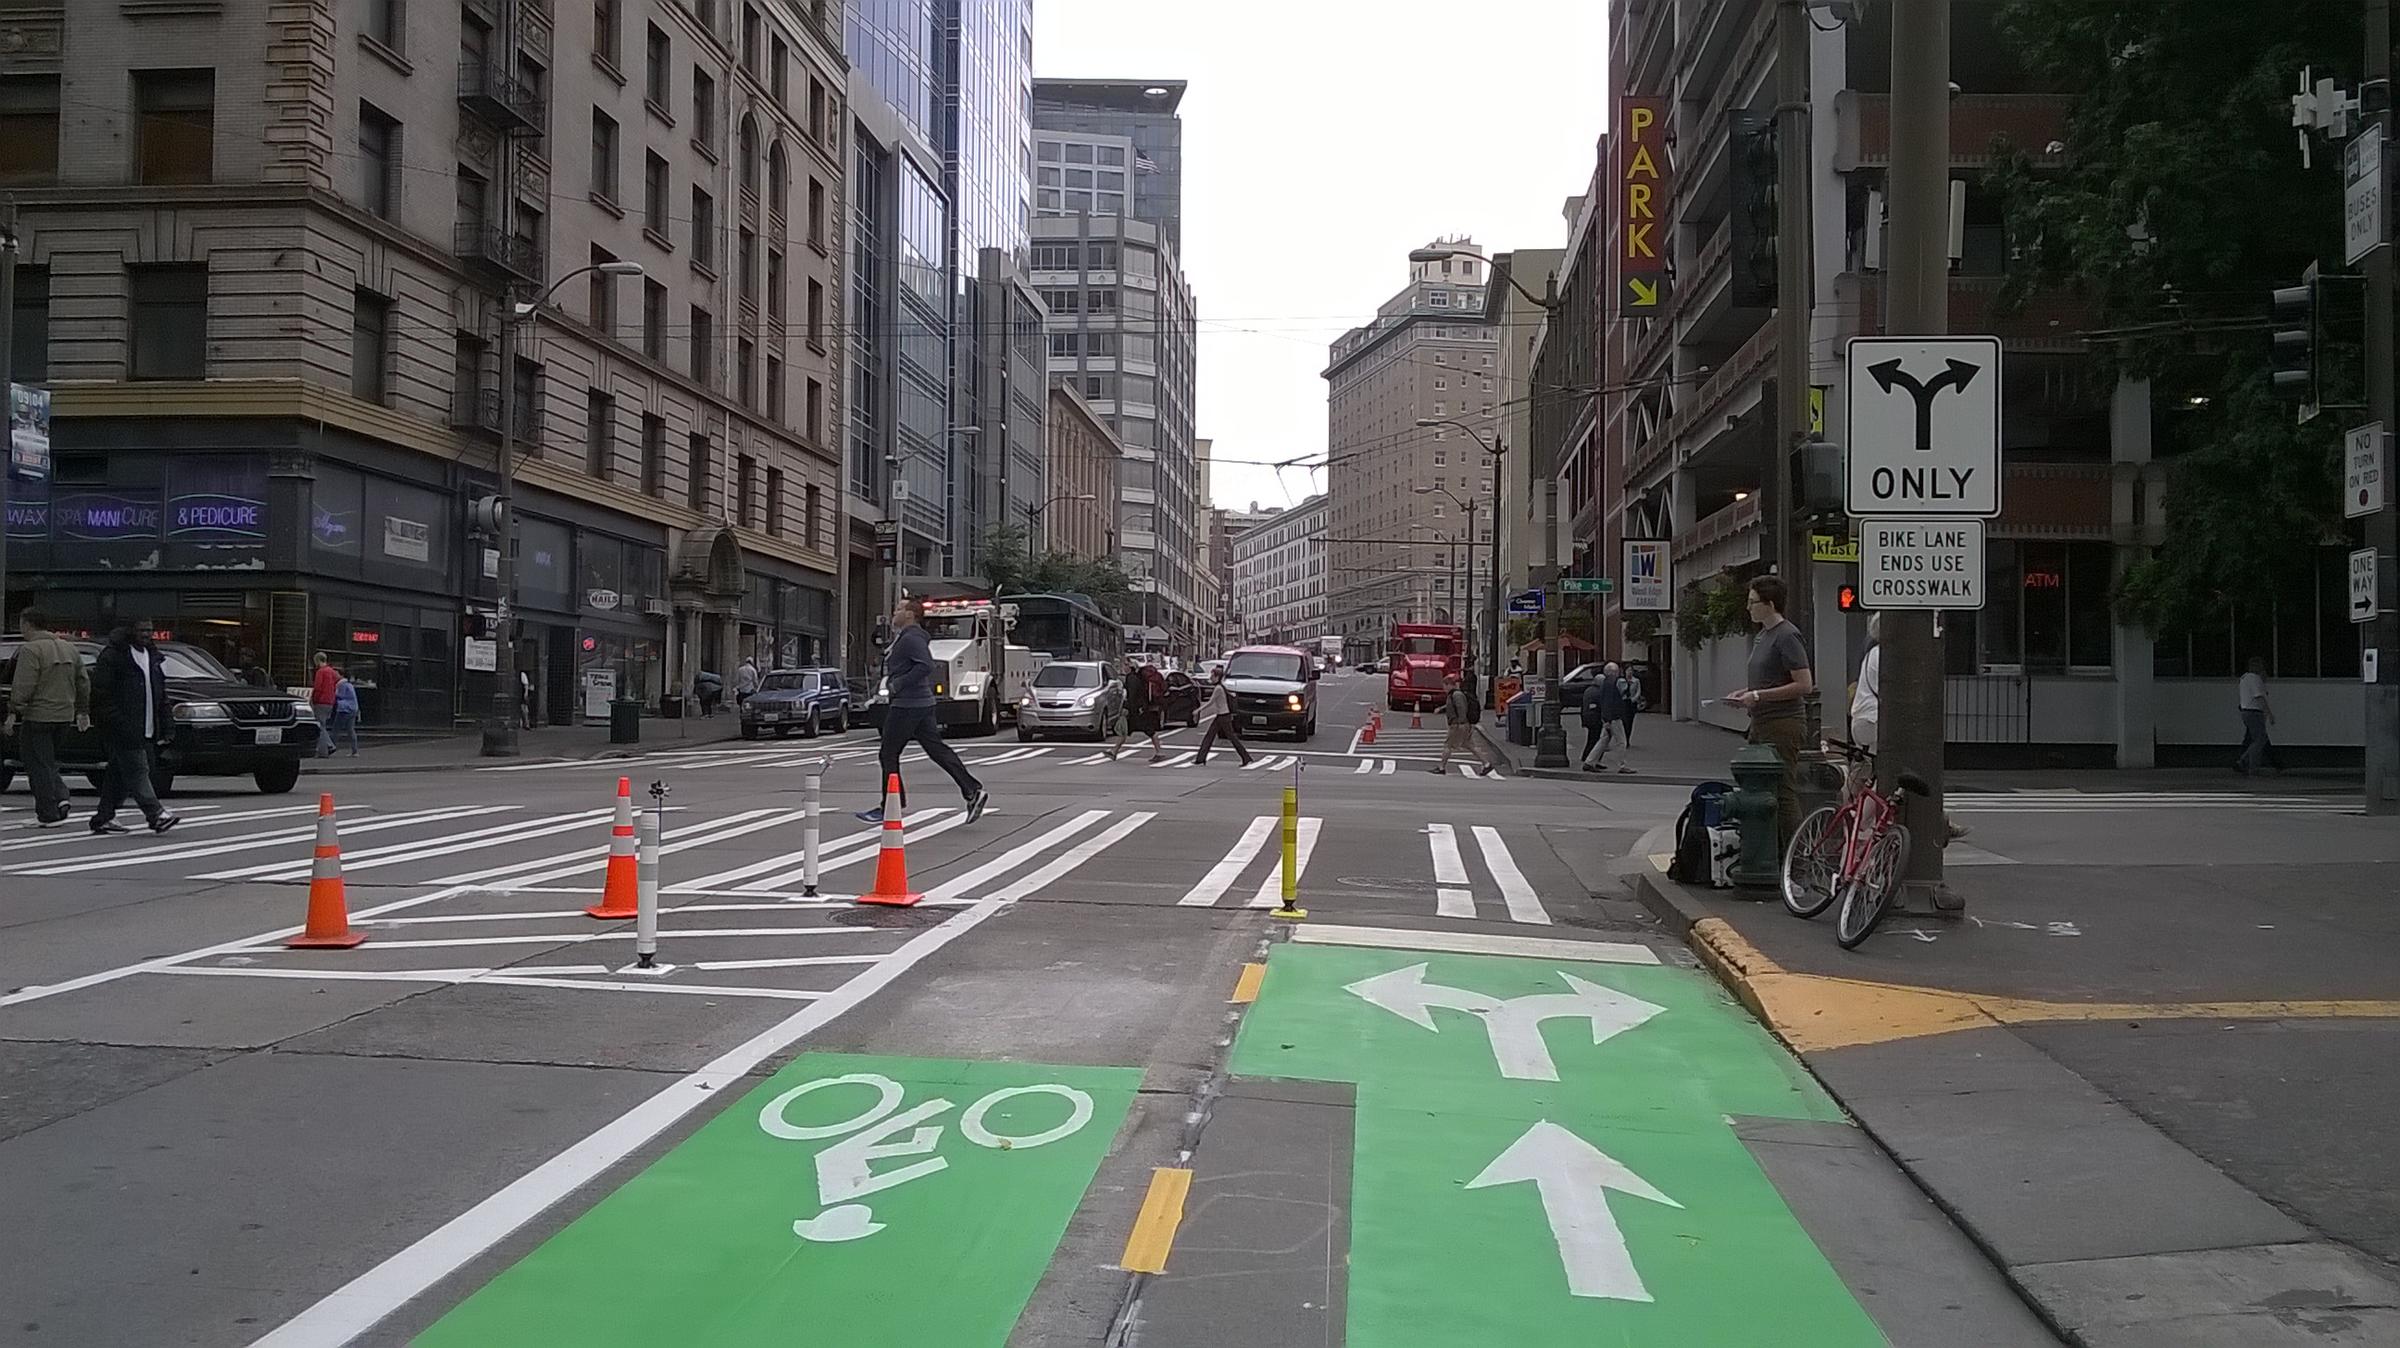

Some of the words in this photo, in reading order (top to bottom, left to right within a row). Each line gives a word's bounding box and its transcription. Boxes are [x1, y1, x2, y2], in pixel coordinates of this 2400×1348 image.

[1626, 108, 1659, 258] PARK
[2349, 187, 2377, 222] BUSES
[2351, 211, 2374, 241] ONLY
[2356, 433, 2371, 451] NO
[2353, 451, 2375, 470] TURN
[1872, 467, 1974, 499] ONLY
[2350, 474, 2360, 488] ON
[2363, 468, 2379, 486] RED
[7, 509, 48, 527] WAX
[178, 507, 188, 526] &
[191, 506, 257, 526] PEDICURE
[1879, 531, 1916, 547] BIKE
[1925, 531, 1967, 547] LANE
[1881, 555, 1924, 572] ENDS
[1932, 555, 1964, 572] USE
[2353, 555, 2373, 575] ONE
[1563, 580, 1582, 591] Pike
[1872, 580, 1972, 596] CROSSWALK
[2024, 573, 2060, 588] ATM
[2353, 574, 2374, 593] WAY
[592, 595, 618, 603] NAILS
